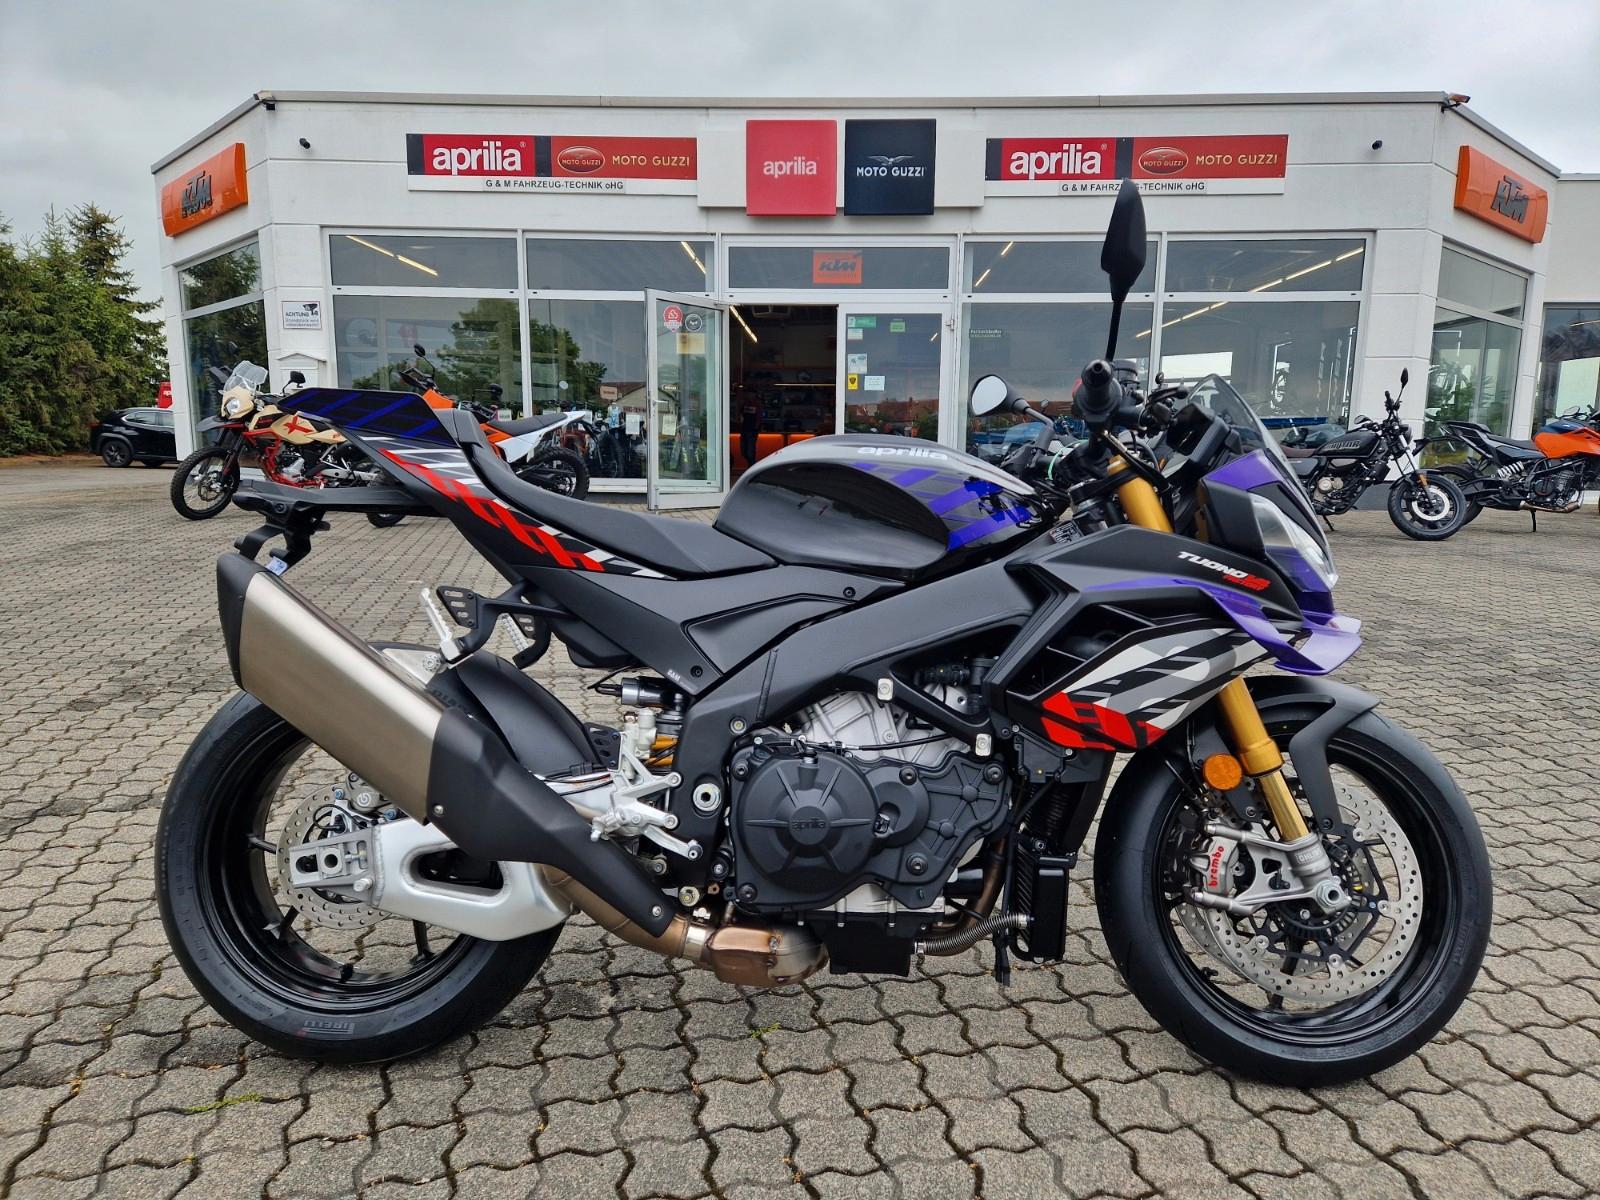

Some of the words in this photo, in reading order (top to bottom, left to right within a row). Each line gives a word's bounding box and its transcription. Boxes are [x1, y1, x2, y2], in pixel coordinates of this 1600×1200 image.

[432, 141, 522, 176] aprilia
[612, 154, 647, 167] MOTO
[652, 155, 690, 168] GUZZI
[1009, 143, 1102, 180] aprilia
[1195, 154, 1232, 166] MOTO
[1237, 153, 1278, 165] GUZZI
[763, 156, 817, 179] aprilia
[856, 166, 888, 177] MOTO
[891, 166, 925, 177] GUZZI
[485, 179, 493, 188] G
[495, 180, 501, 188] &
[503, 180, 511, 188] M
[513, 180, 603, 190] FAHRZEUG-TECHNIK
[605, 181, 624, 190] oHG
[1061, 183, 1069, 192] G
[1071, 183, 1078, 192] &
[1080, 183, 1088, 192] M
[1185, 182, 1205, 191] oHG
[181, 170, 214, 219] KTM
[1490, 174, 1530, 224] KTM
[818, 258, 857, 272] KTM
[857, 446, 948, 461] aprilia
[1177, 551, 1249, 579] TUONO
[1208, 845, 1225, 888] brembo
[303, 1019, 356, 1035] PIRELLI
